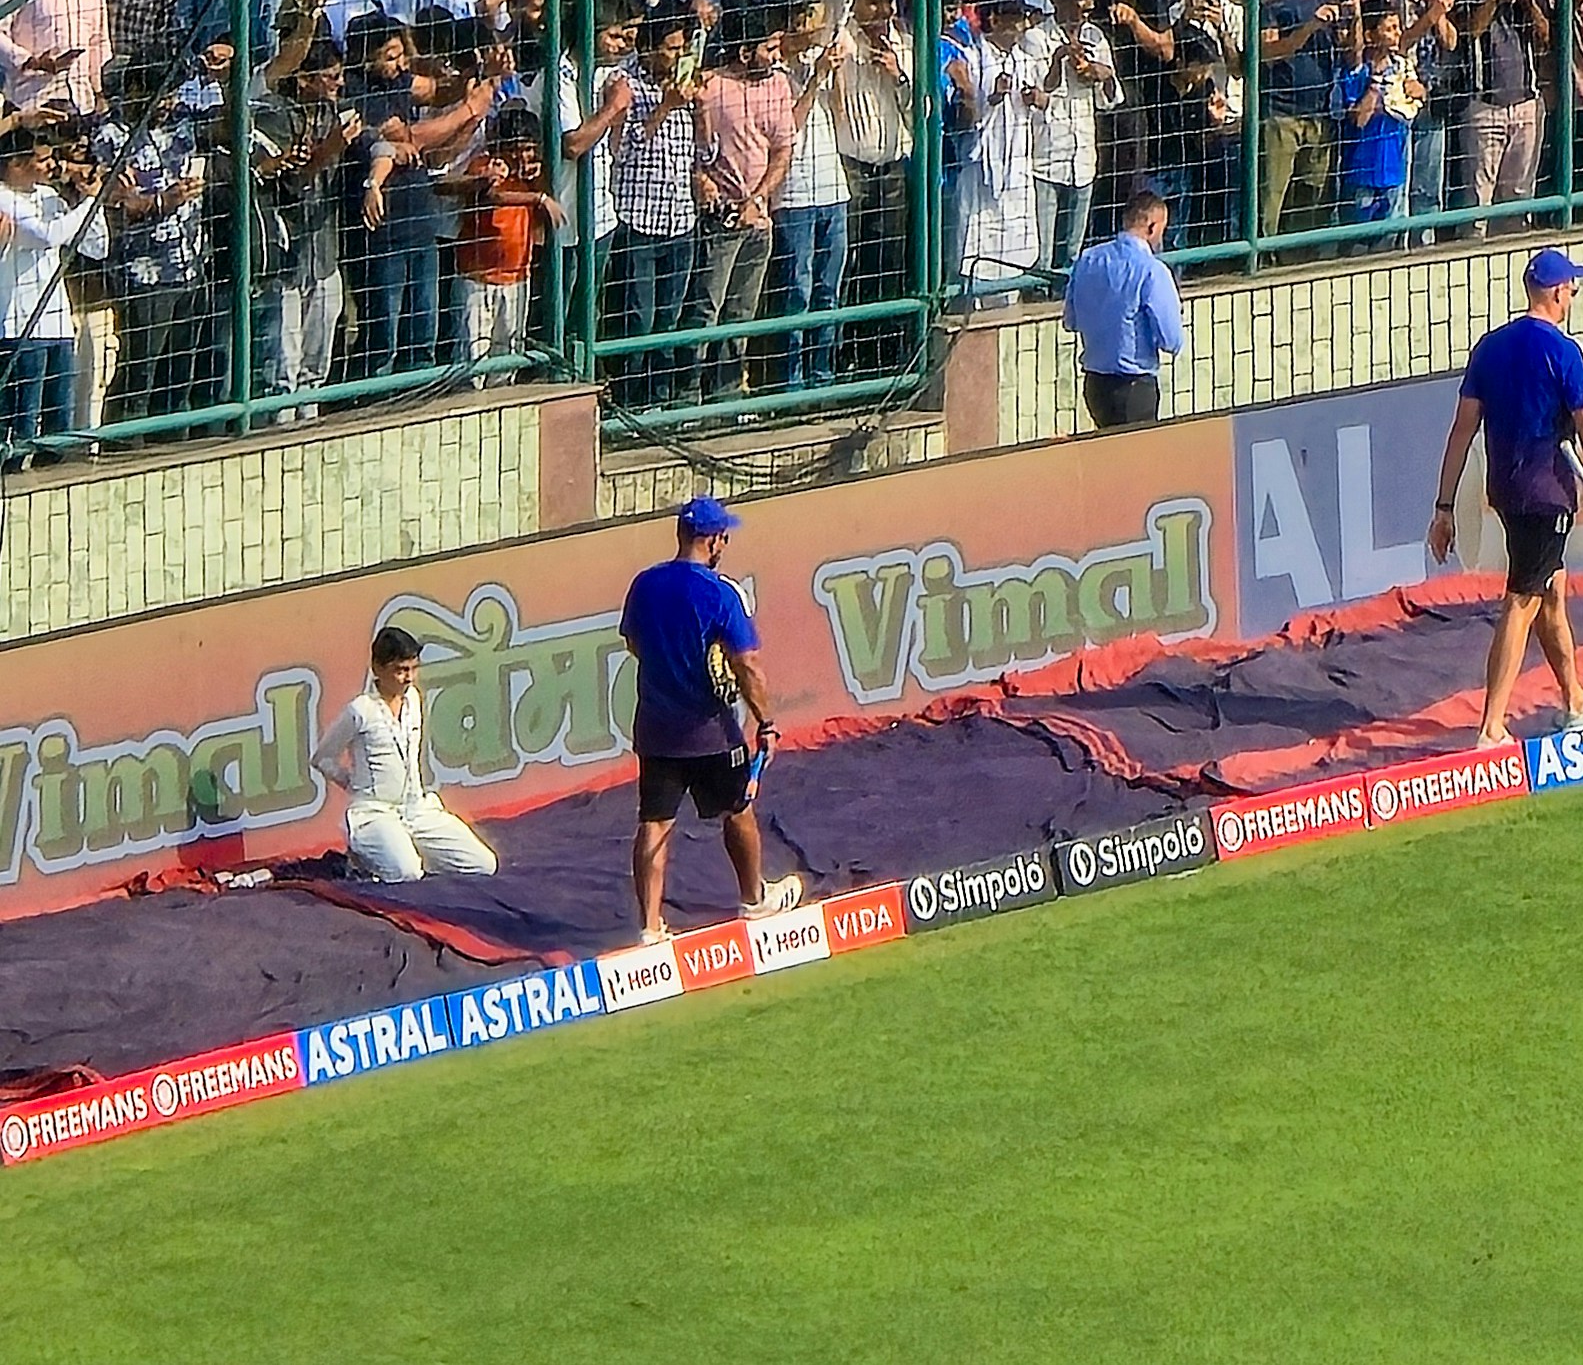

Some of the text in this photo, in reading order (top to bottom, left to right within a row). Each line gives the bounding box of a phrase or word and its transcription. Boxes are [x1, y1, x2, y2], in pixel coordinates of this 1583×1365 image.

[818, 505, 1212, 697] Vimal
[1400, 757, 1521, 810] FREEMANS
[1243, 788, 1363, 842] FREEMANS
[776, 924, 820, 953] Hero
[833, 904, 893, 940] VIDA
[628, 962, 672, 991] Hero
[684, 939, 744, 976] VIDA
[461, 965, 600, 1046] ASTRAL
[308, 1003, 447, 1082] ASTRAL
[180, 1047, 297, 1108] FREEMANS
[28, 1088, 148, 1148] FREEMANS
